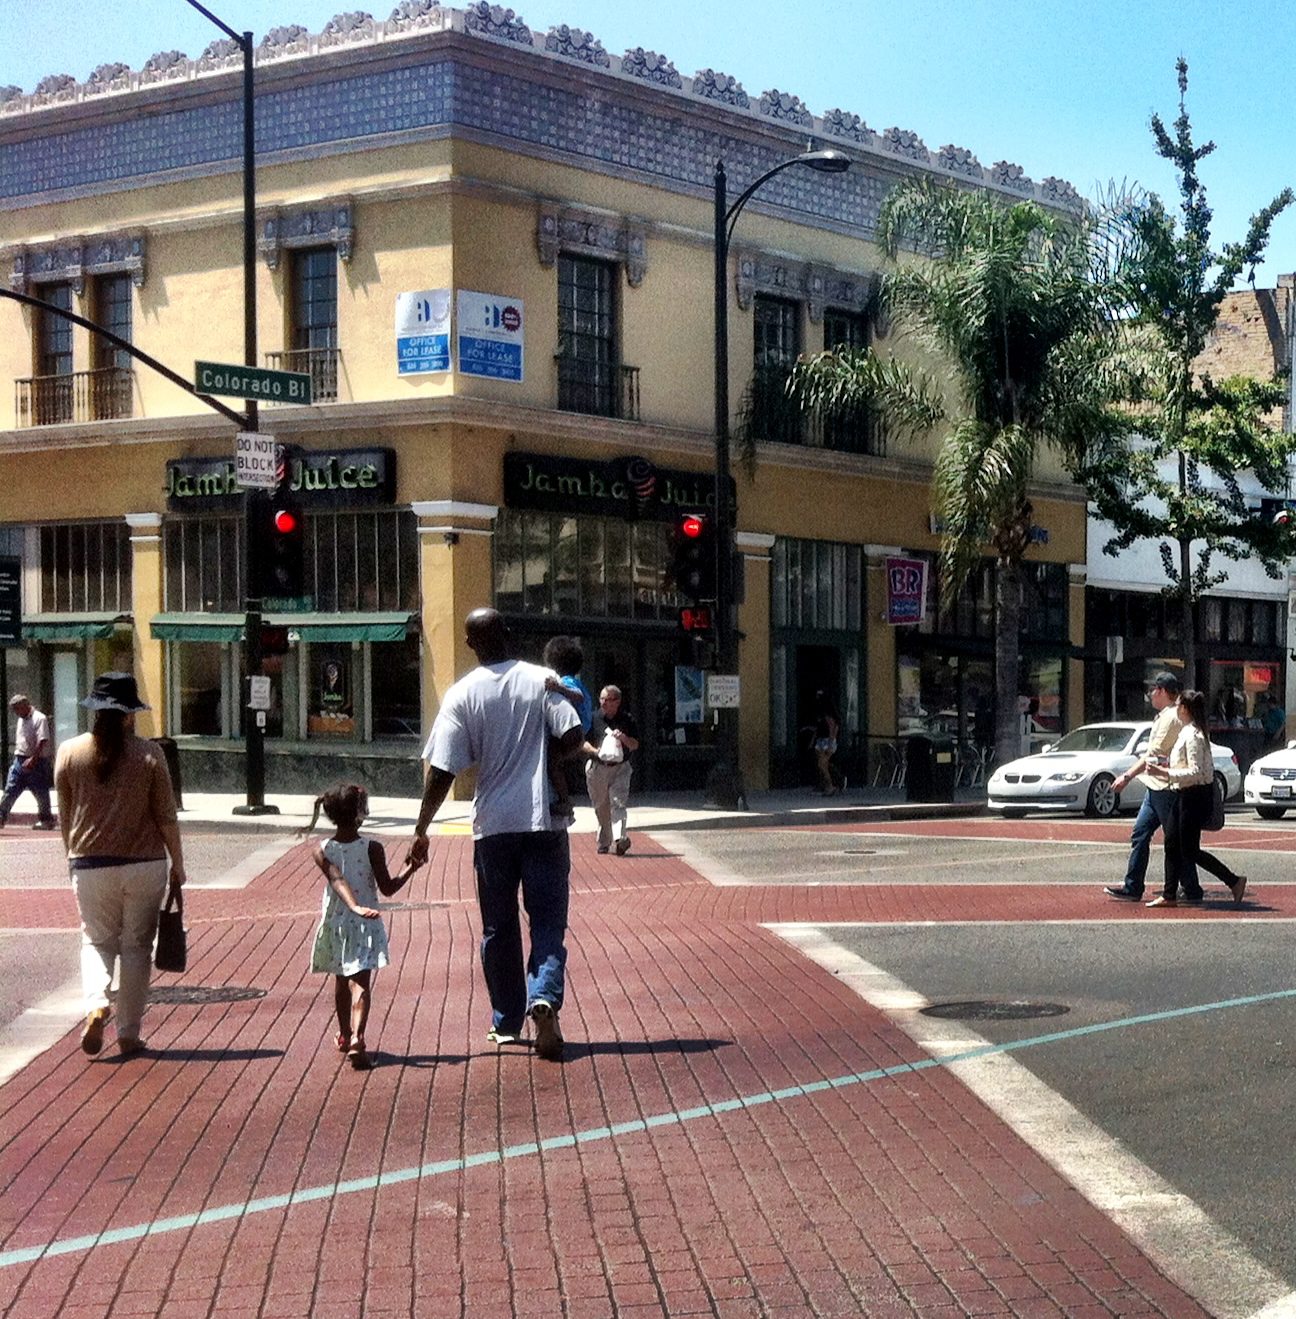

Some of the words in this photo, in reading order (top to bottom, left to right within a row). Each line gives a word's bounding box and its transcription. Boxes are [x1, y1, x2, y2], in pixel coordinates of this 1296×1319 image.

[410, 337, 436, 346] OFFICE
[475, 341, 505, 352] OFFICE
[403, 348, 418, 357] FOR
[421, 345, 442, 355] LEASE
[467, 349, 485, 358] FOR
[488, 351, 513, 363] LEASE
[202, 370, 281, 395] Colorado
[289, 380, 305, 398] Bl
[237, 439, 251, 451] DO
[254, 441, 274, 453] NOT
[237, 456, 274, 471] BLOCK
[165, 460, 244, 496] Jamb
[290, 456, 379, 491] Juice
[520, 464, 629, 500] Jamba
[890, 566, 920, 594] BR
